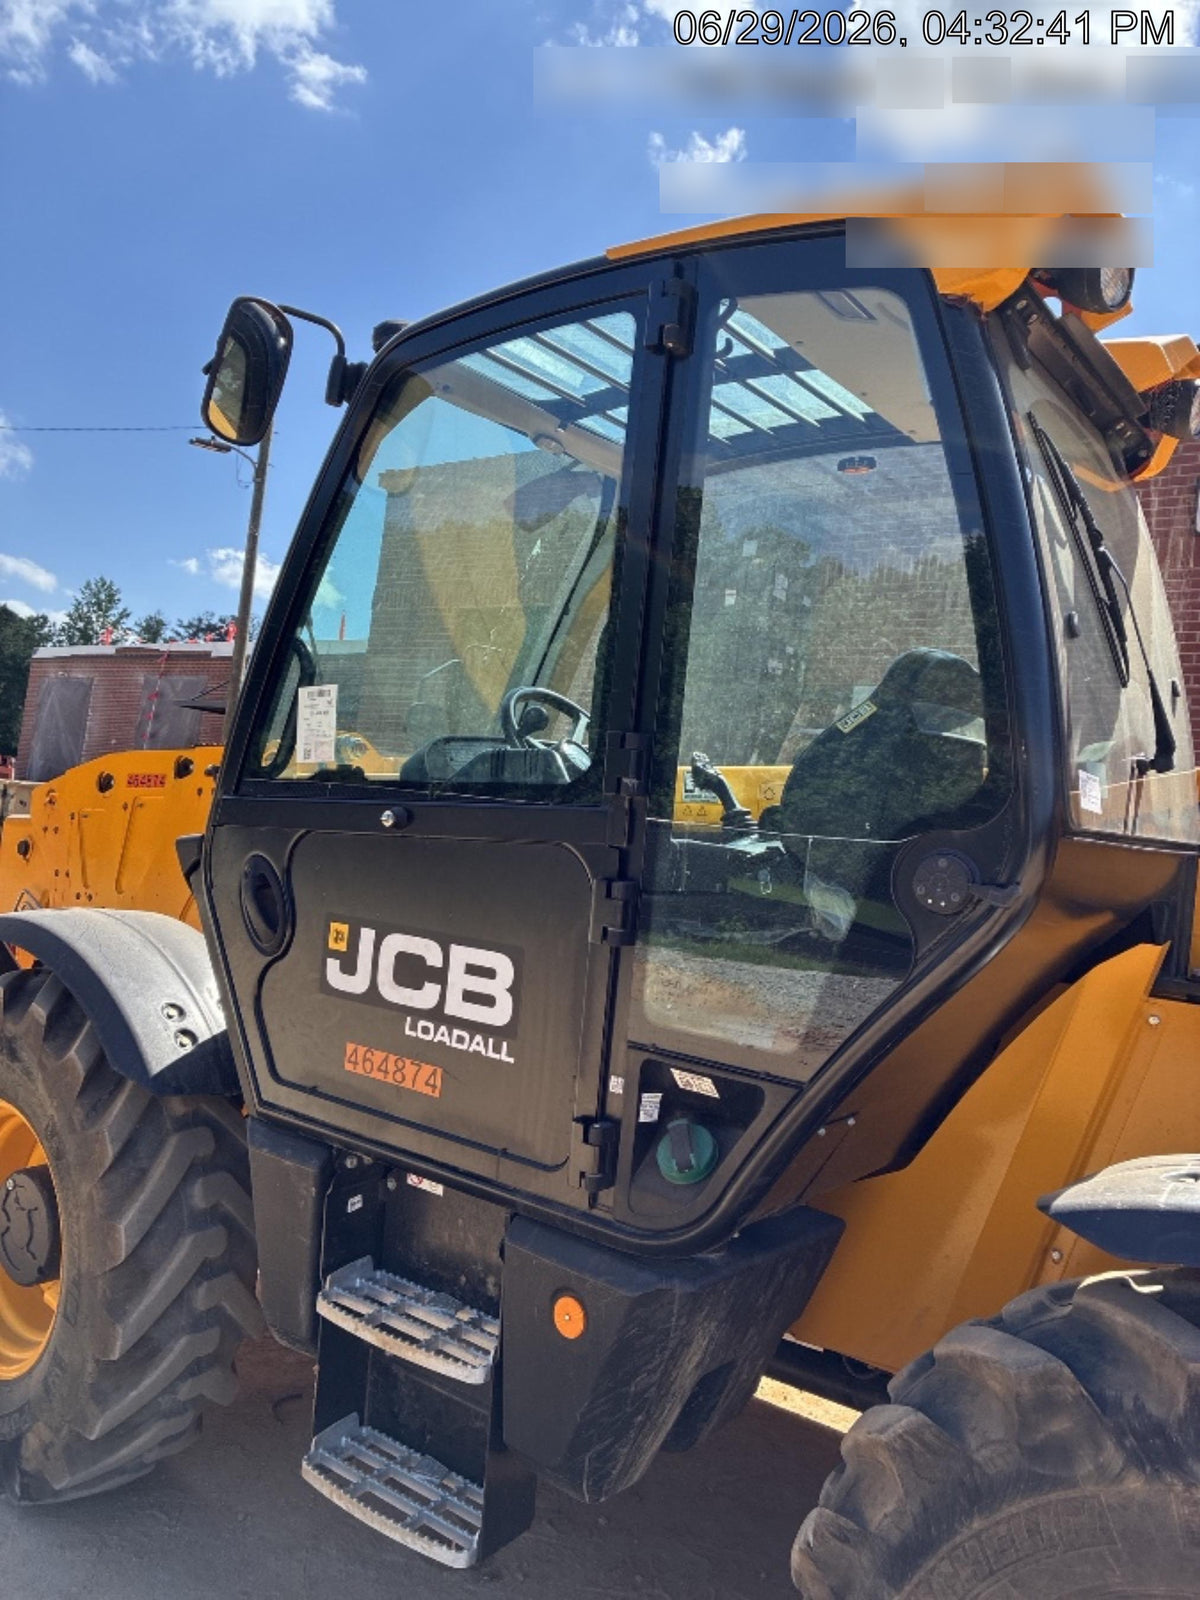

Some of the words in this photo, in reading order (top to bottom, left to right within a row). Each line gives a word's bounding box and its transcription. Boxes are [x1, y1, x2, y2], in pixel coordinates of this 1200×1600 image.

[326, 927, 515, 1026] JCB
[404, 1016, 515, 1064] LOADALL
[346, 1046, 439, 1094] 464874
